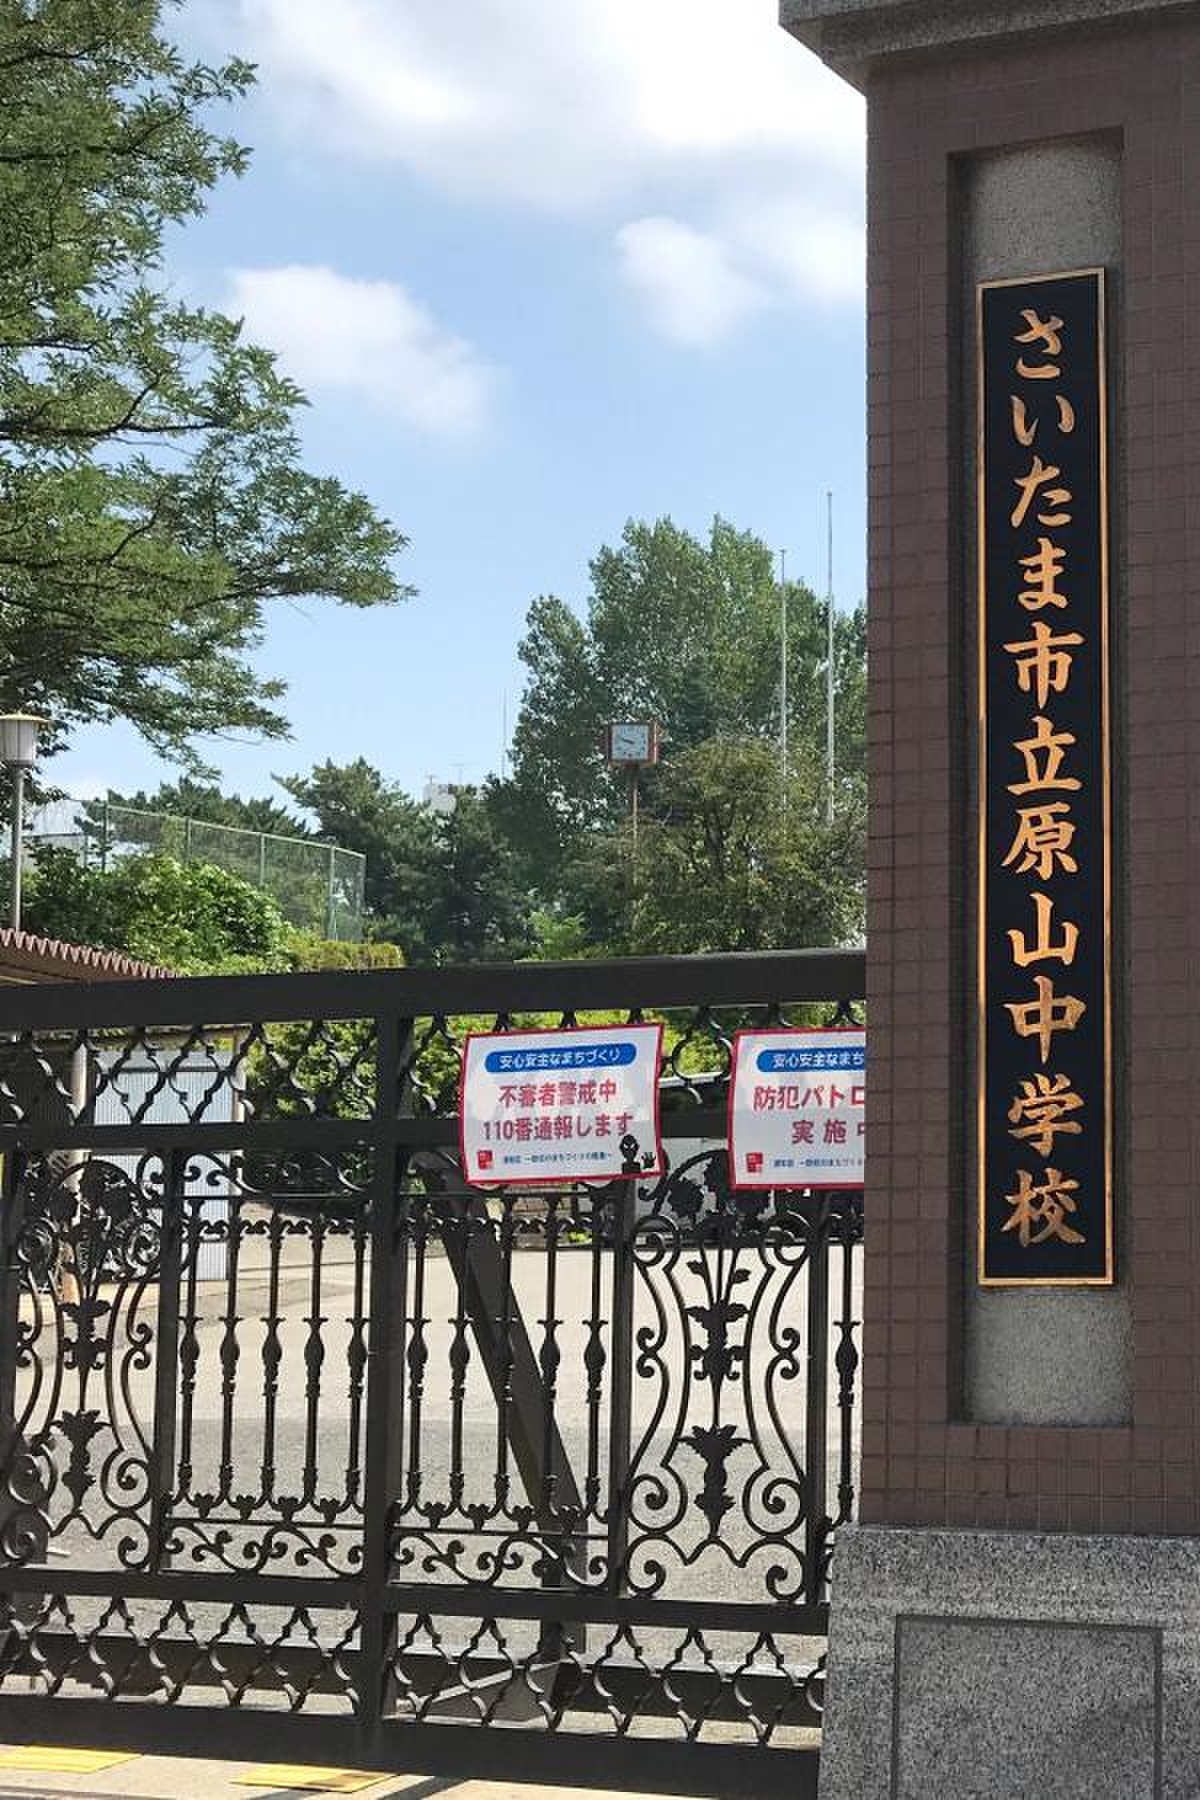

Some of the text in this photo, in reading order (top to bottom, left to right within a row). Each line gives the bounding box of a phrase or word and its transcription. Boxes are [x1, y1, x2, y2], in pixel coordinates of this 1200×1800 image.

[1000, 308, 1087, 1248] さいたま市立原山中学校
[498, 1047, 622, 1069] 安心安全なまちづくり
[498, 1077, 618, 1109] 不審者警戒中
[483, 1112, 634, 1142] 110番通報します
